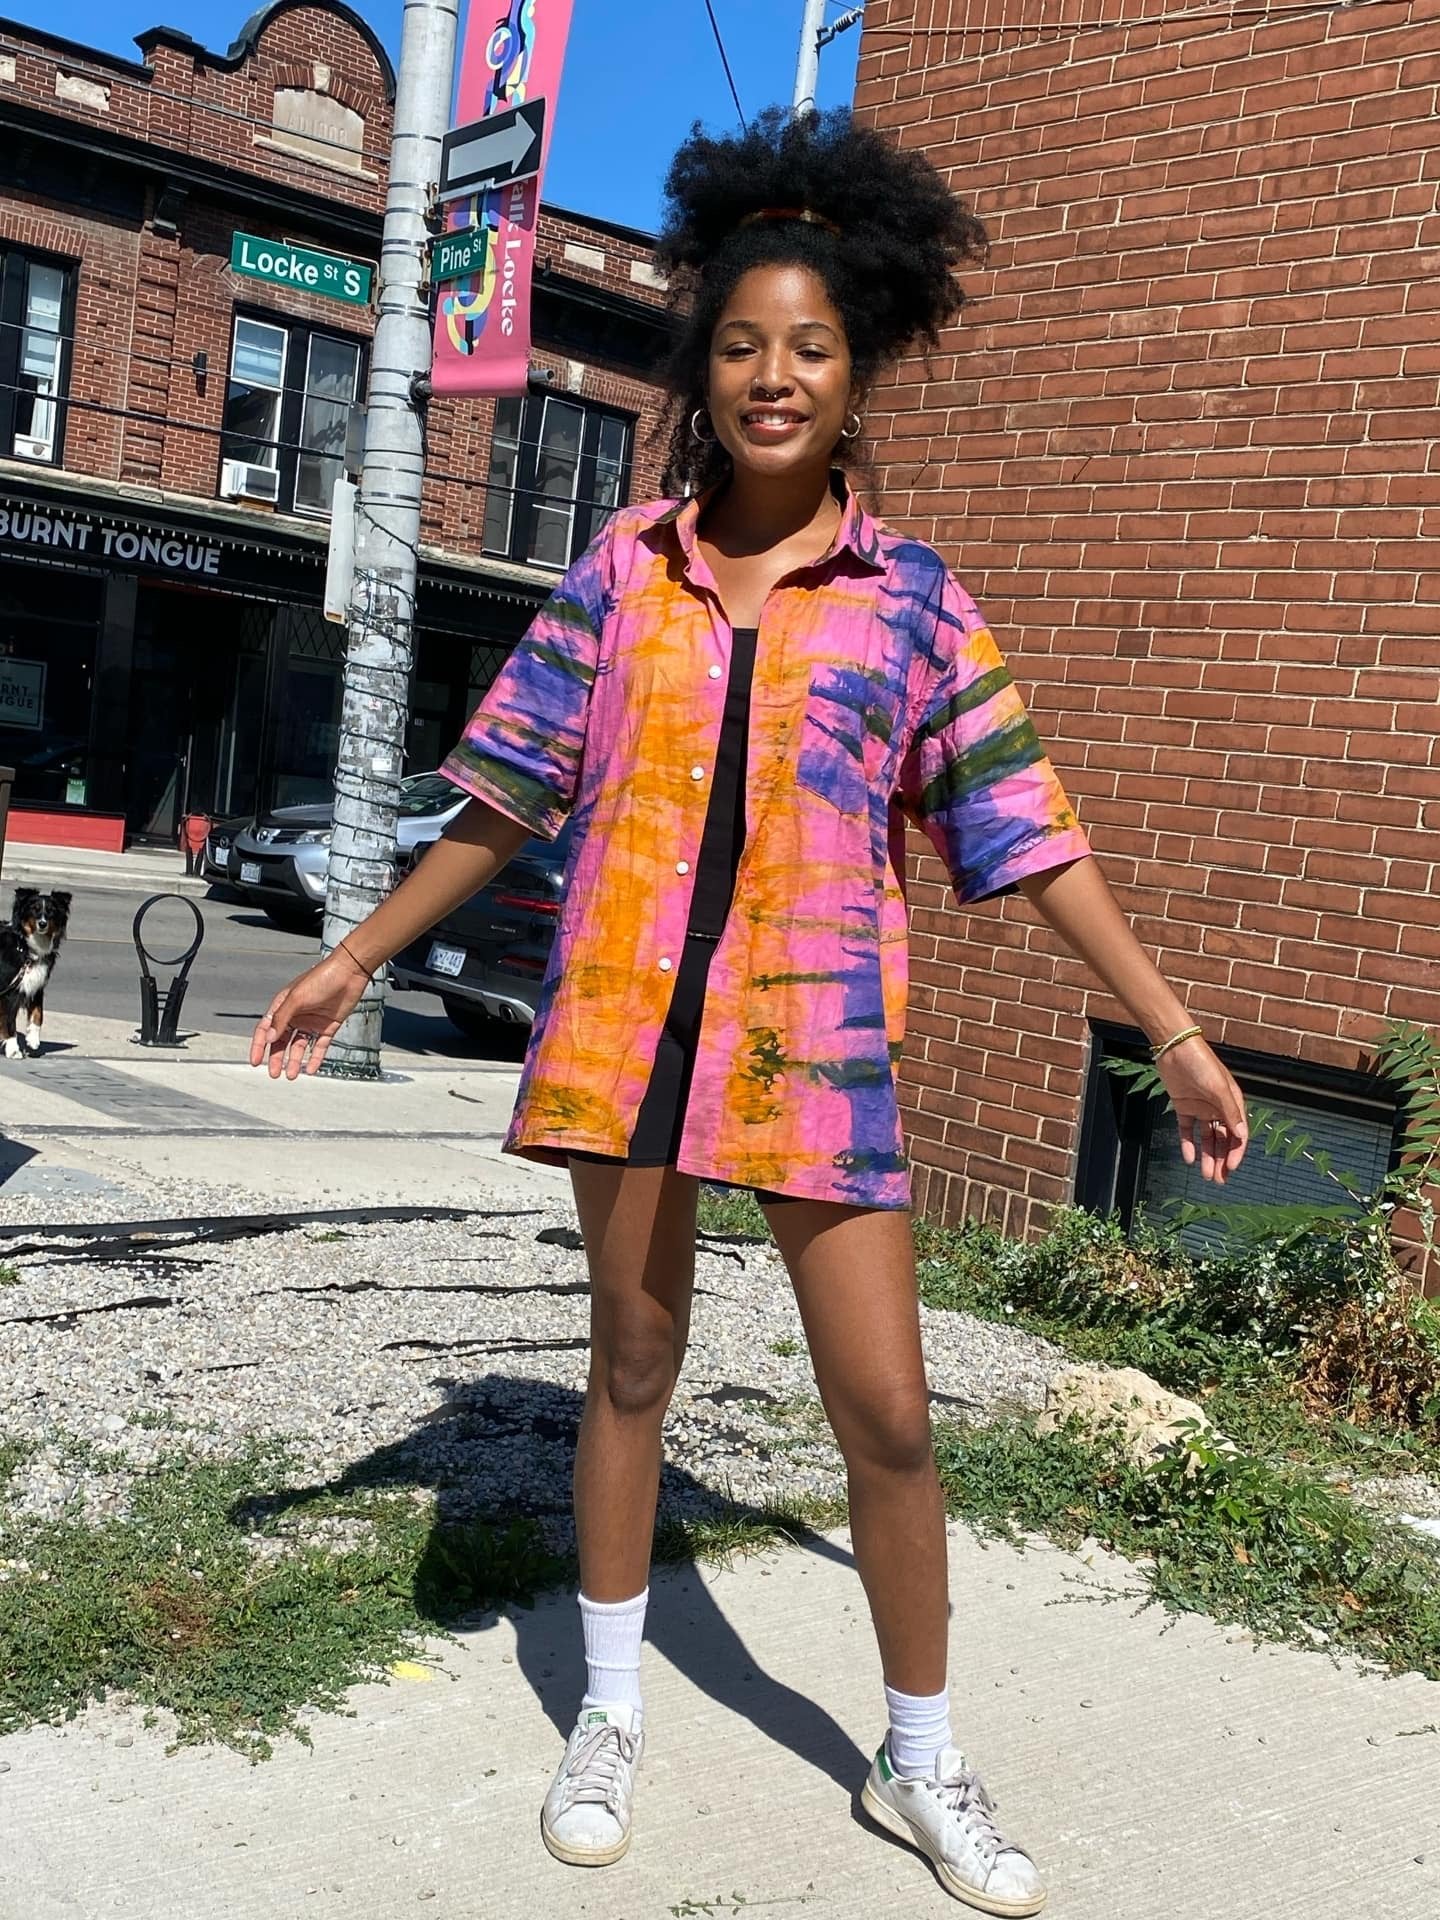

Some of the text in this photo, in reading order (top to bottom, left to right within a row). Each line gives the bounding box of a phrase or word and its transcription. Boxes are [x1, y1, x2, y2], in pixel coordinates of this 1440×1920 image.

[241, 241, 361, 297] Locke St S
[440, 237, 482, 273] Pine St
[501, 179, 528, 337] alk Locke
[101, 527, 221, 574] TONGUE
